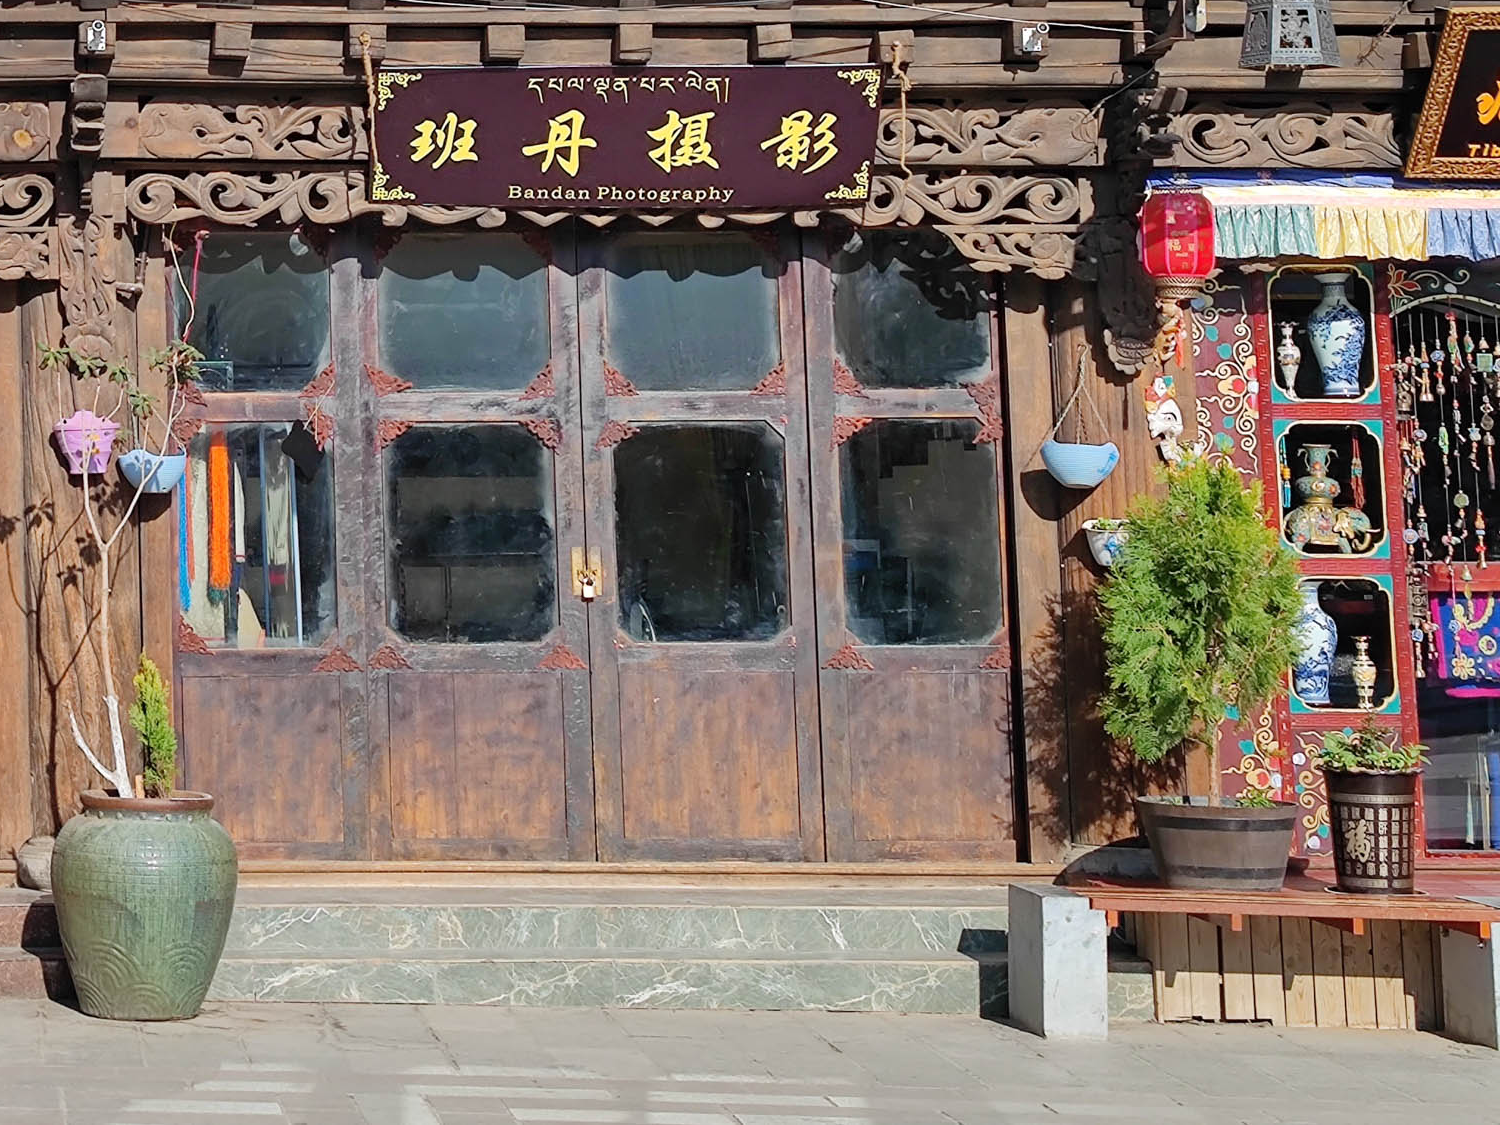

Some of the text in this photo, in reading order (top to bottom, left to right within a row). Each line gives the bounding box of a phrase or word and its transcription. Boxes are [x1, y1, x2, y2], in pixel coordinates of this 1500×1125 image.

[409, 109, 840, 175] 班丹摄影
[508, 185, 735, 203] Bandan Photography
